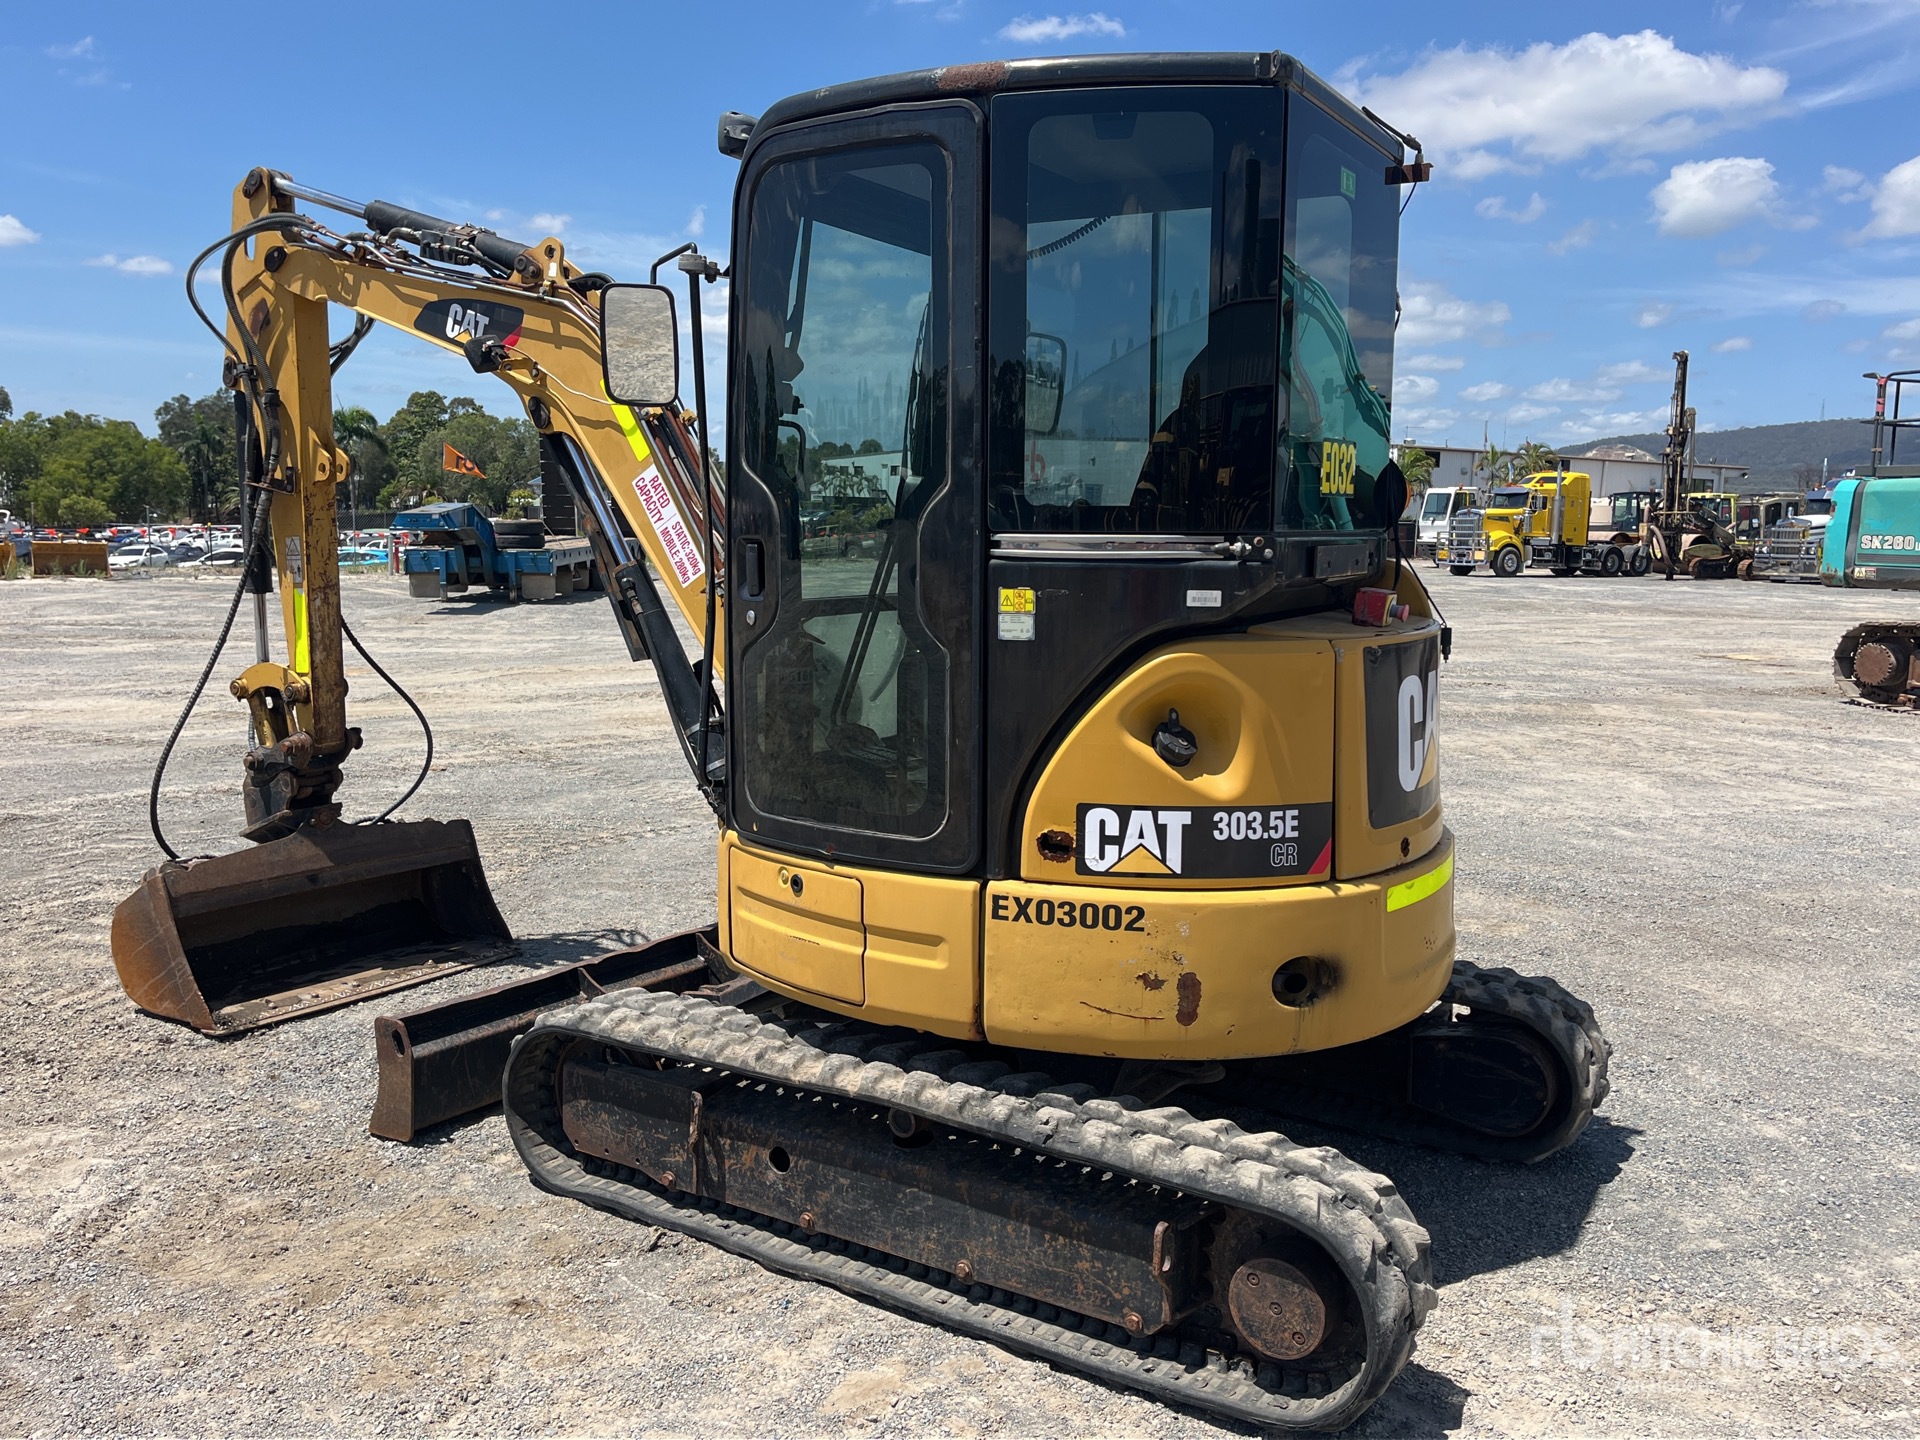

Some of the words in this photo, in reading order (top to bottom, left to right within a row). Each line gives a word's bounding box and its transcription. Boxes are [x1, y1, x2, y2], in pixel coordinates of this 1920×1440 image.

[446, 303, 490, 339] CAT
[1321, 441, 1356, 494] E032
[634, 477, 665, 524] CAPACITY
[648, 474, 671, 509] RATED
[674, 557, 690, 585] 280kg
[685, 548, 701, 576] 320kg
[1084, 807, 1192, 875] CAT
[1212, 809, 1299, 841] 303.5E
[1270, 843, 1298, 867] CR
[991, 894, 1145, 932] EX03002
